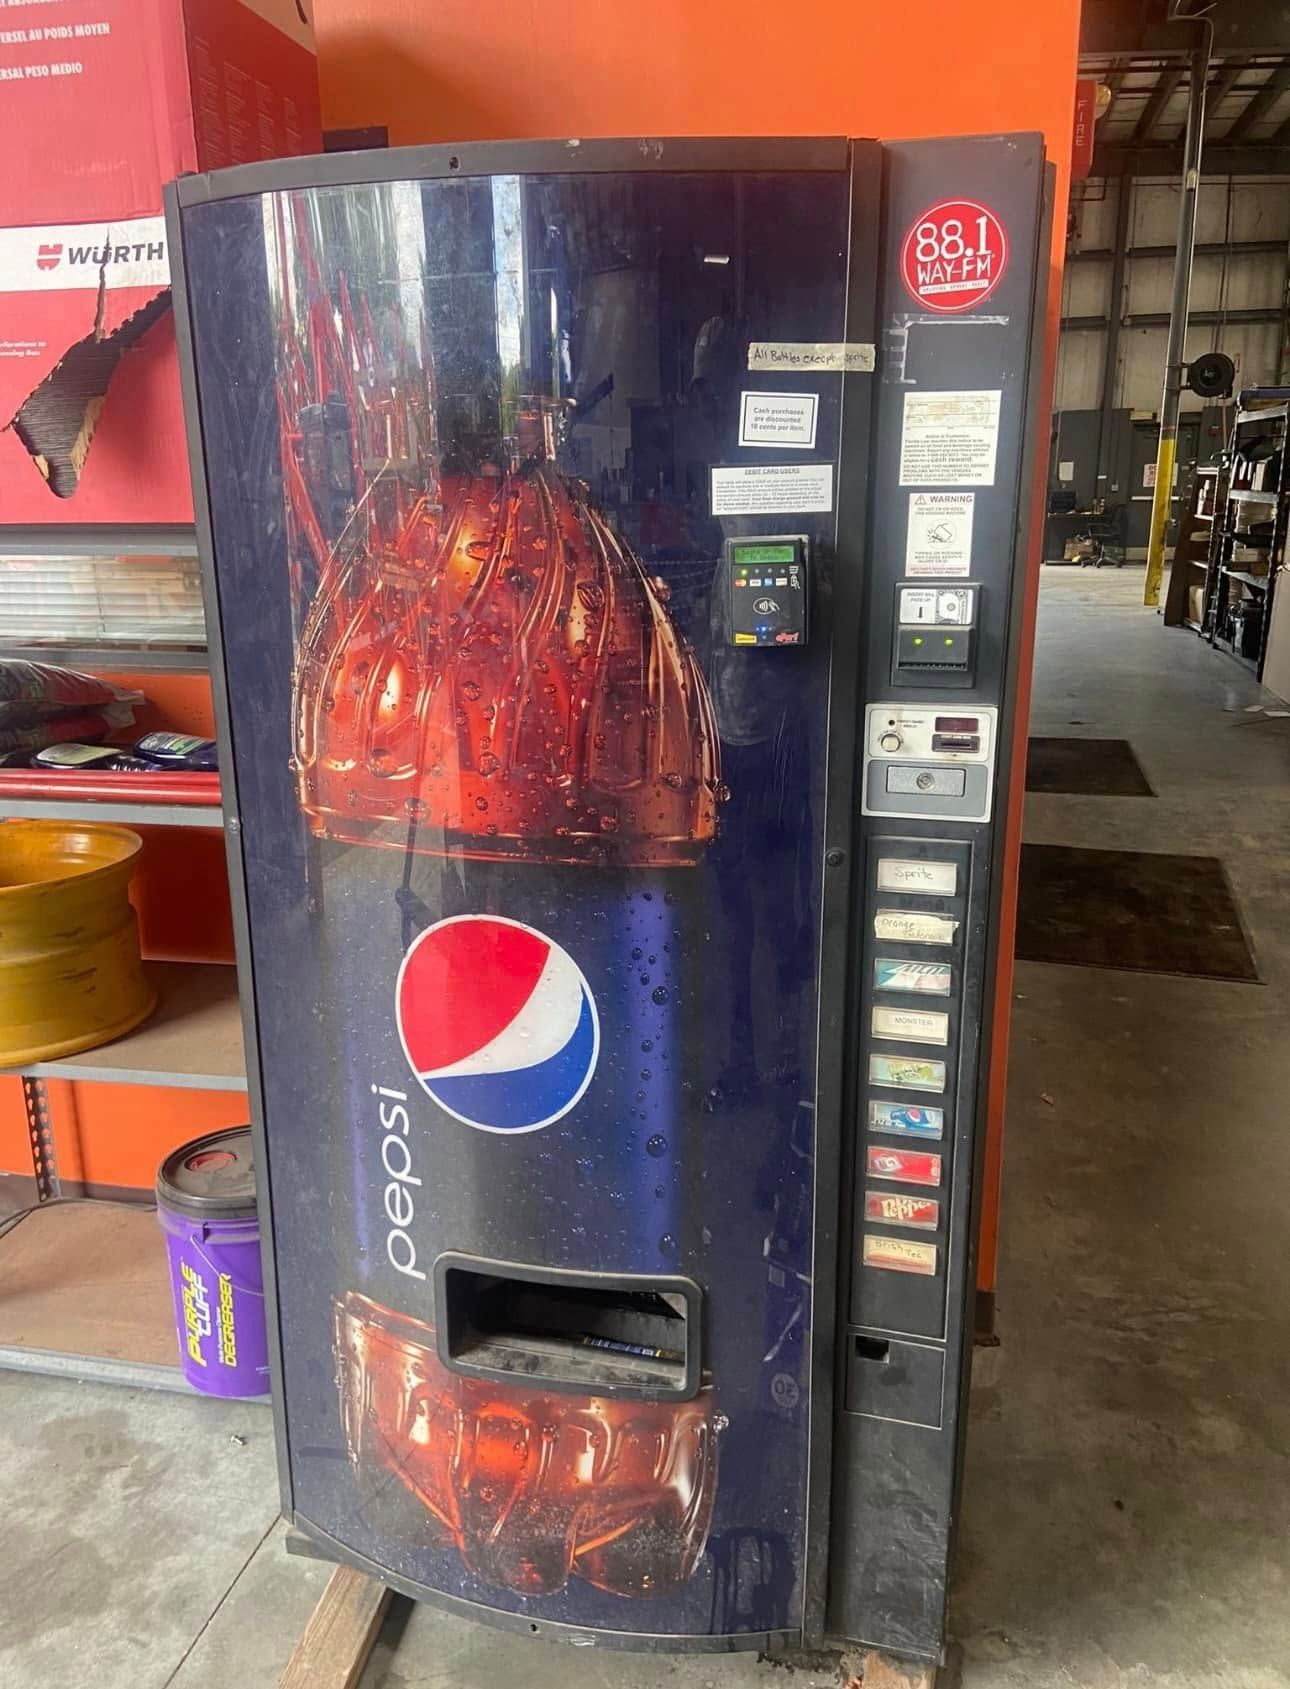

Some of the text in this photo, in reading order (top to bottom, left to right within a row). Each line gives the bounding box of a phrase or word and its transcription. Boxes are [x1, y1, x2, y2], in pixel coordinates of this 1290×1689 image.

[0, 22, 111, 44] ERSEL AU POIDS MOYEN
[25, 64, 49, 79] PESO
[50, 61, 83, 76] MEDIO
[1075, 99, 1089, 147] FIRE
[915, 215, 992, 263] 88.1
[68, 241, 164, 265] WÜRTH
[916, 255, 992, 285] WAY-FM
[754, 347, 768, 360] All
[770, 350, 800, 364] Bottles
[802, 352, 835, 366] except
[753, 407, 804, 416] Cash purchases
[765, 416, 801, 424] discounted
[930, 495, 973, 503] WARNING
[894, 865, 934, 881] Sprite
[895, 1017, 933, 1026] MONSTER
[371, 1084, 426, 1280] pepsi
[180, 1261, 207, 1368] PURPLE
[218, 1273, 237, 1368] DEGREASER
